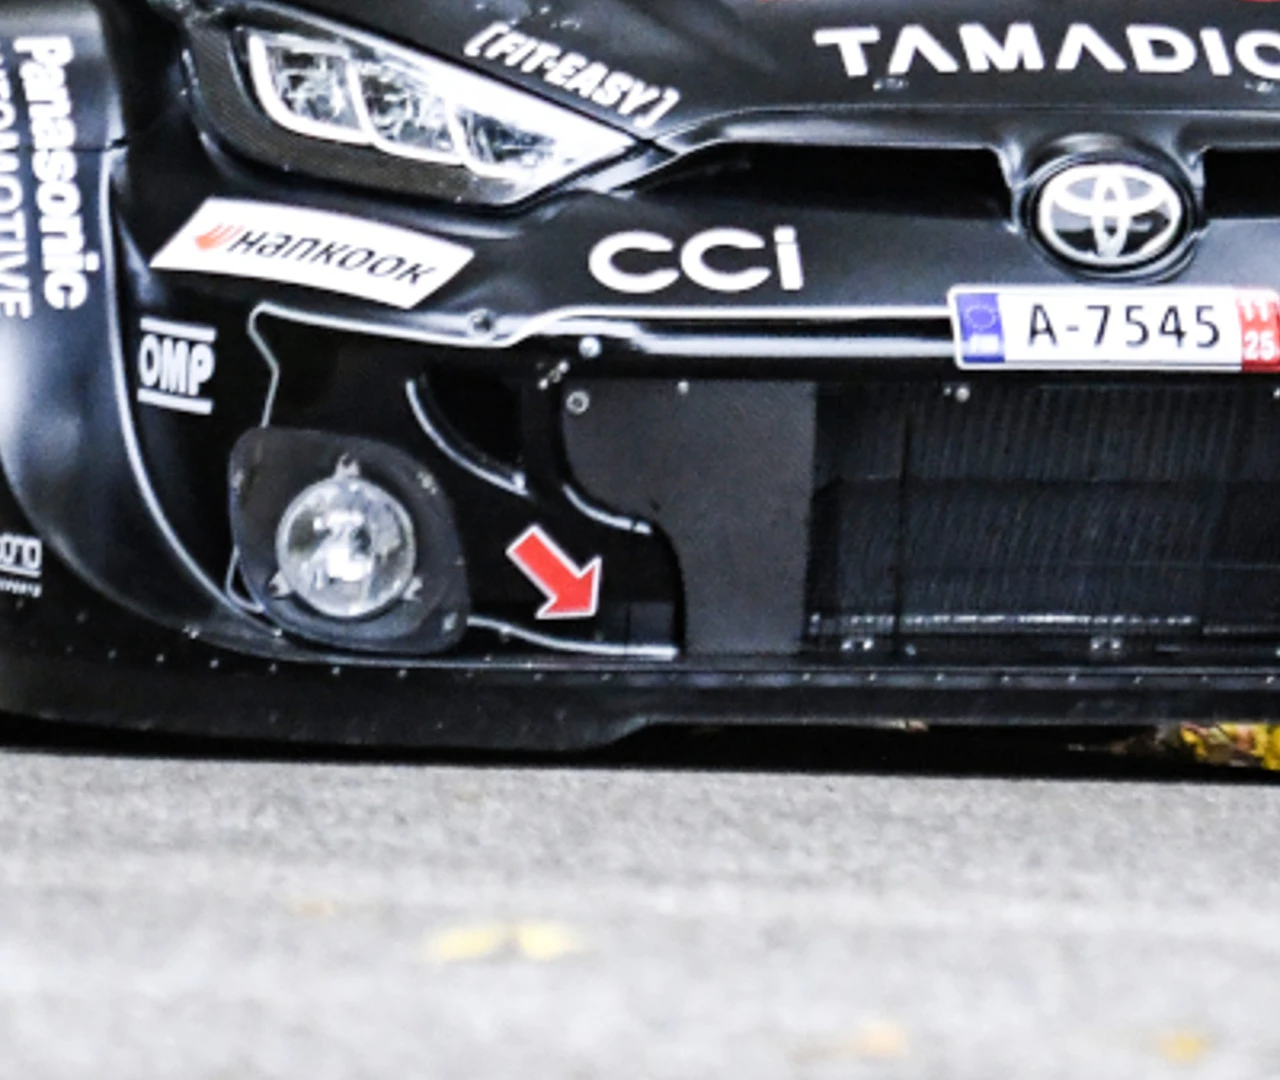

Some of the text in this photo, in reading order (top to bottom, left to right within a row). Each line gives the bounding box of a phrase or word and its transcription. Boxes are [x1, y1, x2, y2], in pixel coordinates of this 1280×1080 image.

[14, 36, 100, 309] Panasonic
[1028, 304, 1220, 349] A-7545
[1244, 330, 1276, 361] 25
[137, 329, 215, 397] OMP
